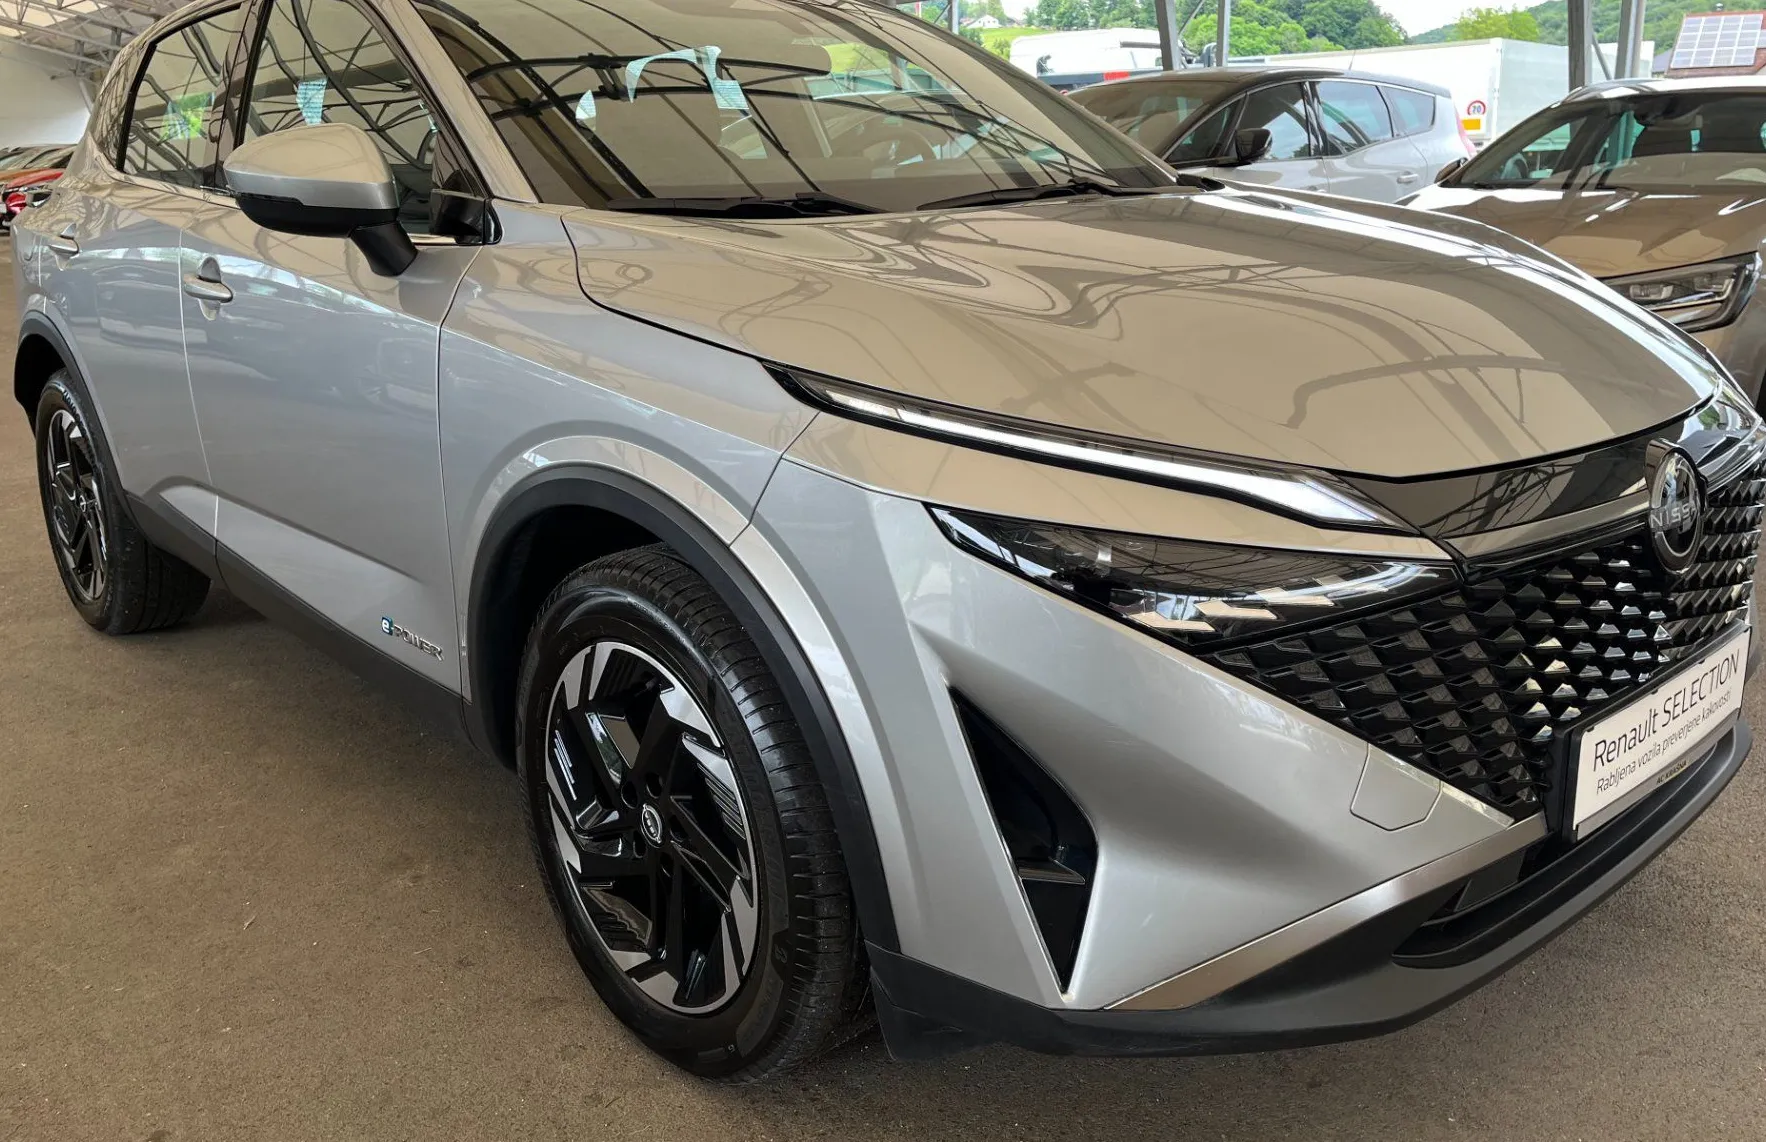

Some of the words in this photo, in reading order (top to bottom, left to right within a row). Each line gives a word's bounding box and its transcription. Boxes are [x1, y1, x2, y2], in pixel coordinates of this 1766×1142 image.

[1650, 502, 1697, 529] NISS
[1593, 708, 1659, 772] Renault
[1661, 648, 1740, 728] SELECTION
[1596, 760, 1636, 795] Rabljena
[1637, 742, 1661, 768] vozila
[1661, 715, 1701, 757] preverjene
